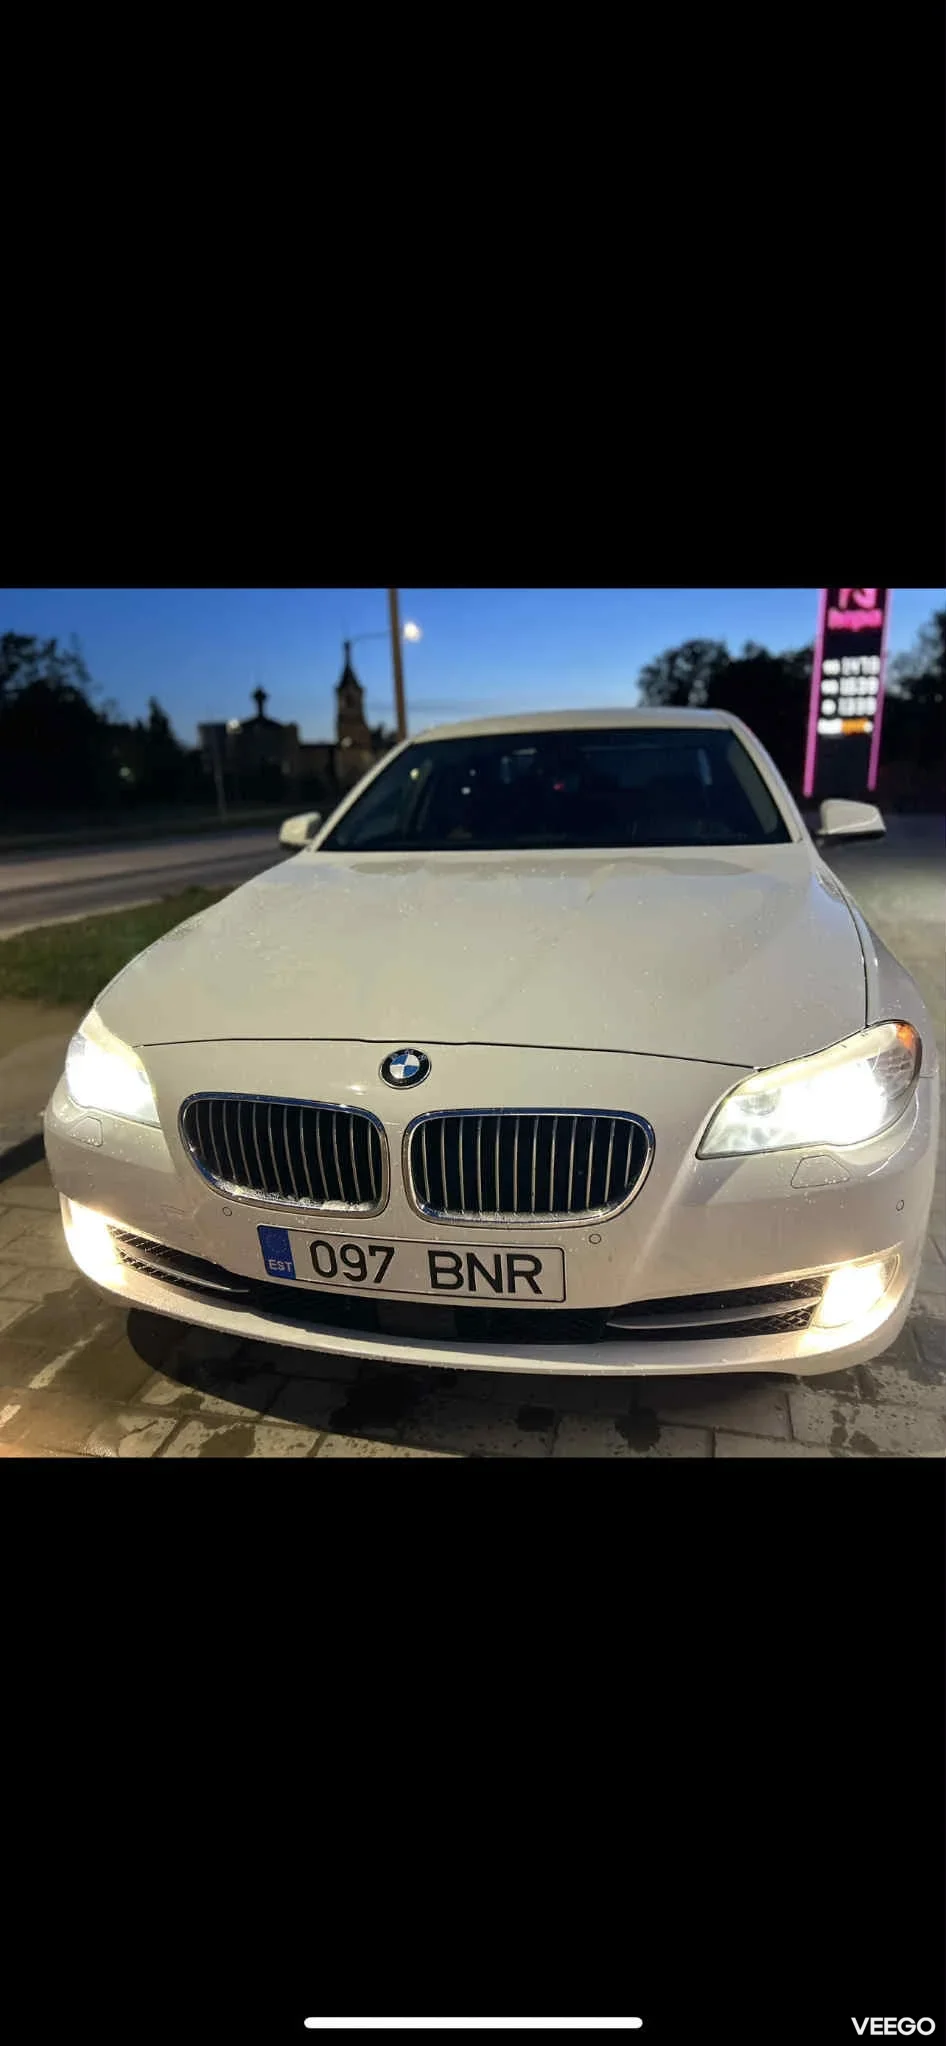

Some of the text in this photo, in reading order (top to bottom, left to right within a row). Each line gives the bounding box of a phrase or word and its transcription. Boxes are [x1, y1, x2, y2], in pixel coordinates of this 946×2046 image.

[268, 1259, 292, 1273] EST
[309, 1239, 543, 1294] 097 BNR
